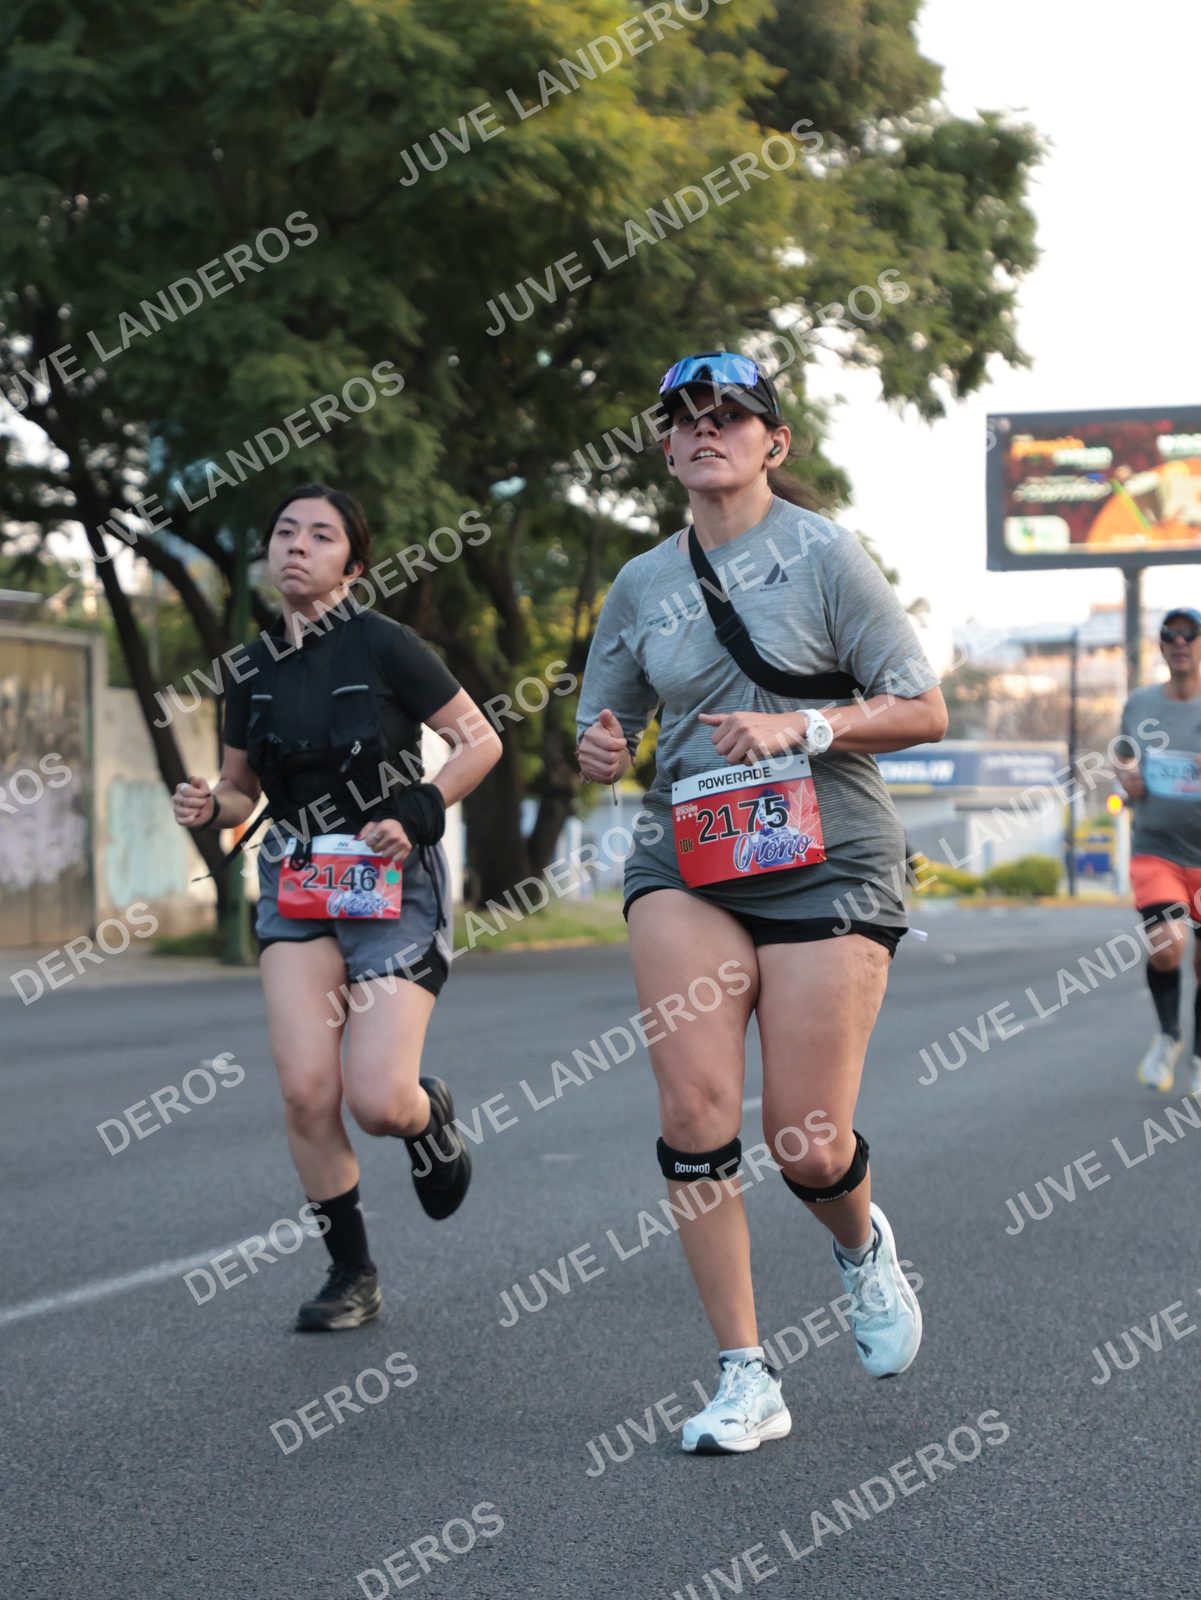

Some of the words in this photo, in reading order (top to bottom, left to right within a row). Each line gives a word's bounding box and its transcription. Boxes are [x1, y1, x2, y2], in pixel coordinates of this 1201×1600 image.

[698, 766, 772, 791] POWERADE
[696, 794, 788, 845] 2175
[302, 864, 377, 891] 2146
[674, 1162, 711, 1175] GOUNOD
